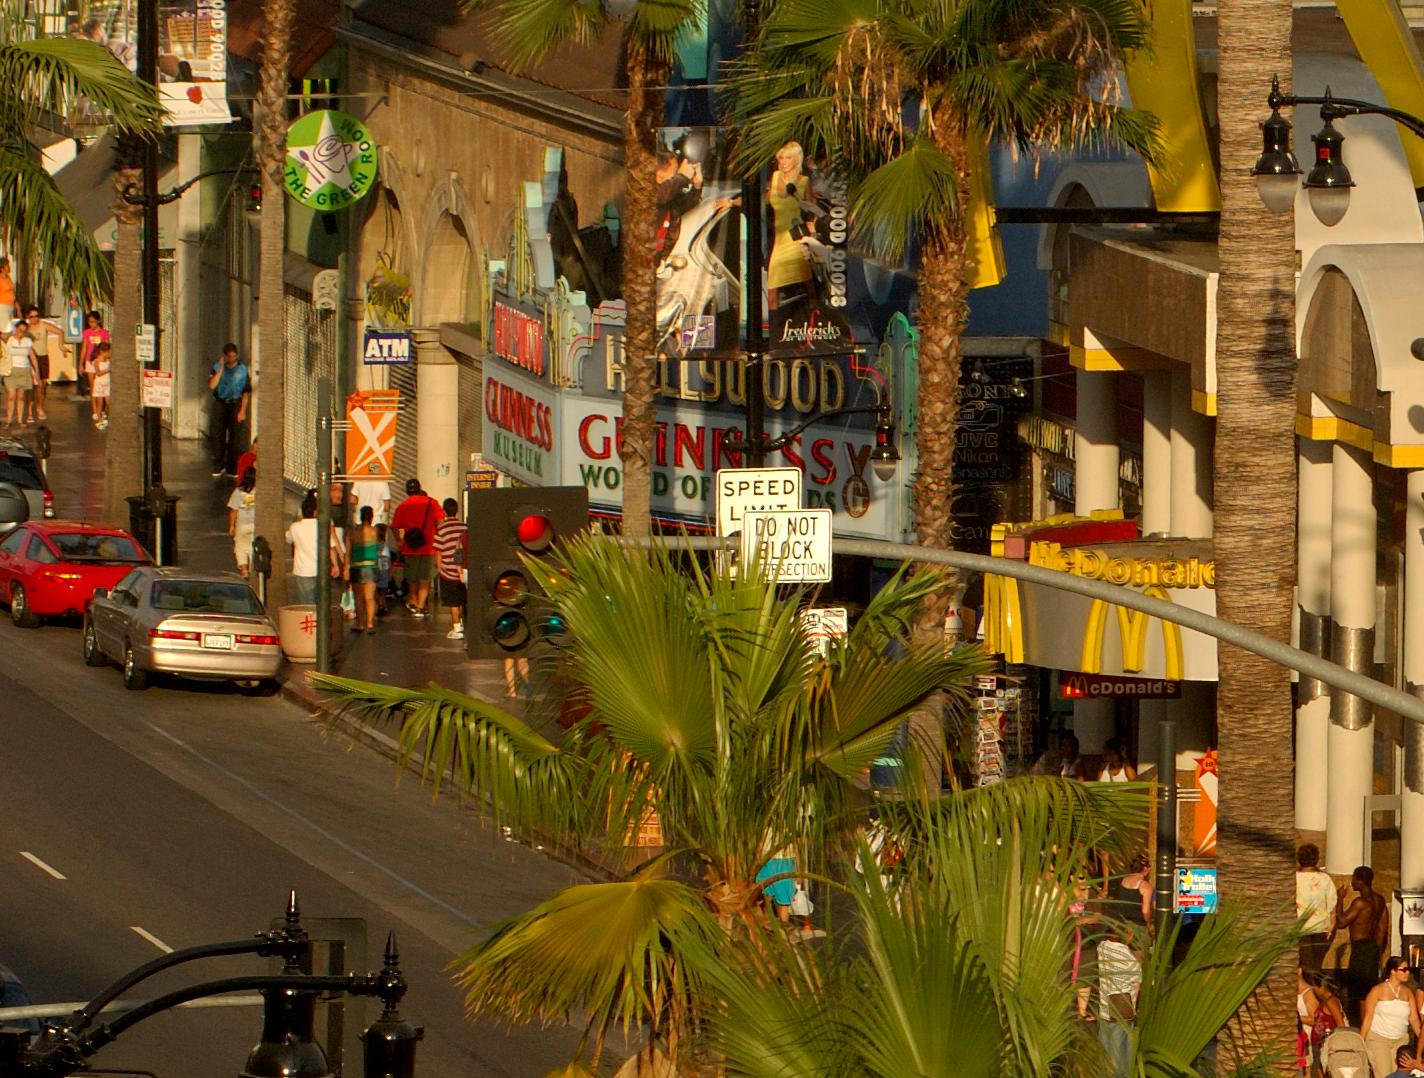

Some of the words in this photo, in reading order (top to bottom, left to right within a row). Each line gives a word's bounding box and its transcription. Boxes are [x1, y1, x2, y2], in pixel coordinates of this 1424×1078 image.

[209, 32, 224, 81] 90028
[286, 167, 311, 200] THE
[316, 172, 369, 206] GREEN
[830, 250, 847, 307] 90028
[365, 338, 409, 357] ATM
[485, 376, 553, 452] GUINNESS
[578, 413, 837, 486] GINNSS
[955, 432, 998, 448] JVC
[494, 430, 543, 477] MUSEUM
[955, 449, 998, 464] Nikon
[579, 464, 669, 496] WOD
[952, 465, 1013, 480] anasonic
[724, 480, 795, 497] SPEED
[756, 517, 777, 537] DO
[788, 517, 818, 537] NOT
[760, 541, 813, 560] BLOCK
